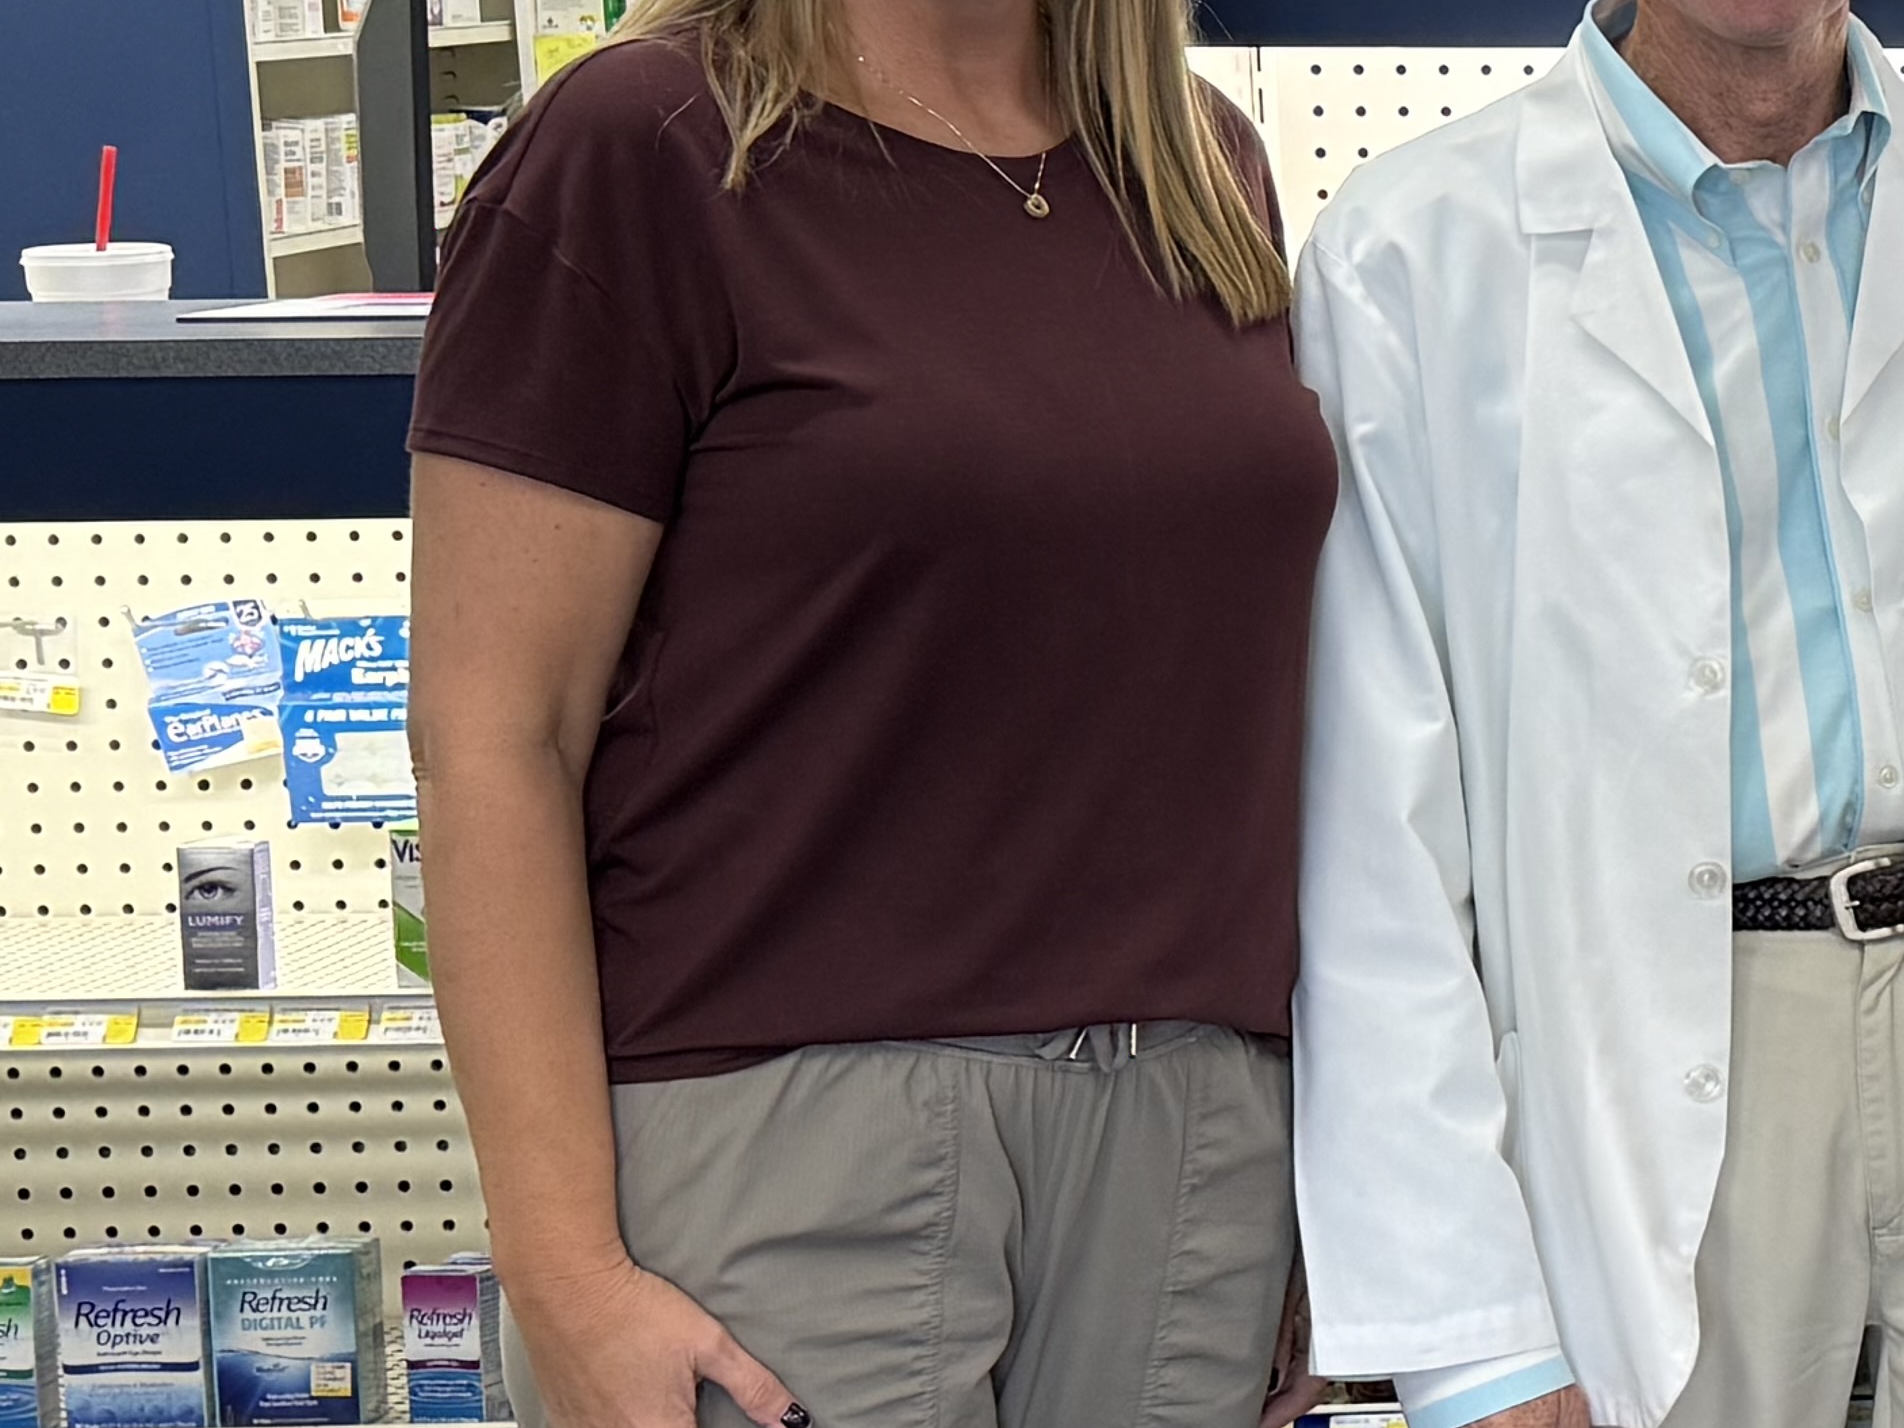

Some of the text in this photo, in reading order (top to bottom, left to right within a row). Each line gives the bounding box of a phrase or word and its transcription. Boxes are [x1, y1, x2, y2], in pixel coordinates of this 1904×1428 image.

[188, 915, 244, 926] LUMIFY
[239, 1288, 329, 1313] Refresh
[74, 1298, 181, 1329] Refresh
[409, 1308, 472, 1326] Refresh
[241, 1316, 304, 1331] DIGITAL
[96, 1329, 160, 1349] Optive
